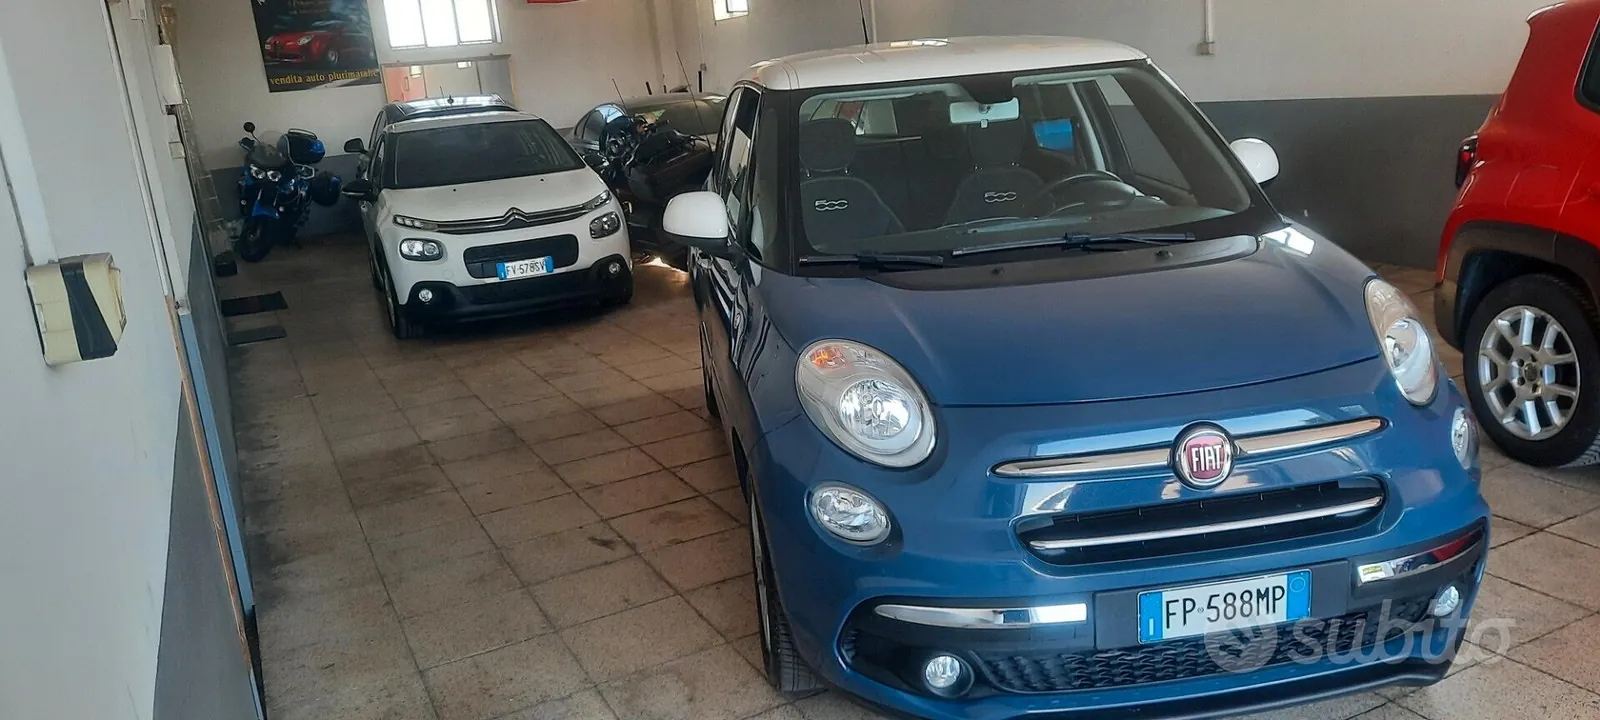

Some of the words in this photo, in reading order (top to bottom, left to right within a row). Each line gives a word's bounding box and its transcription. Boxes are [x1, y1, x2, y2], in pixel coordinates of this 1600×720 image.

[270, 73, 303, 85] vendita
[306, 73, 325, 82] auto
[985, 191, 1017, 203] 500
[815, 200, 848, 211] 500
[1191, 444, 1222, 472] FIAT
[1165, 597, 1197, 629] FP
[1206, 585, 1286, 622] 588MP
